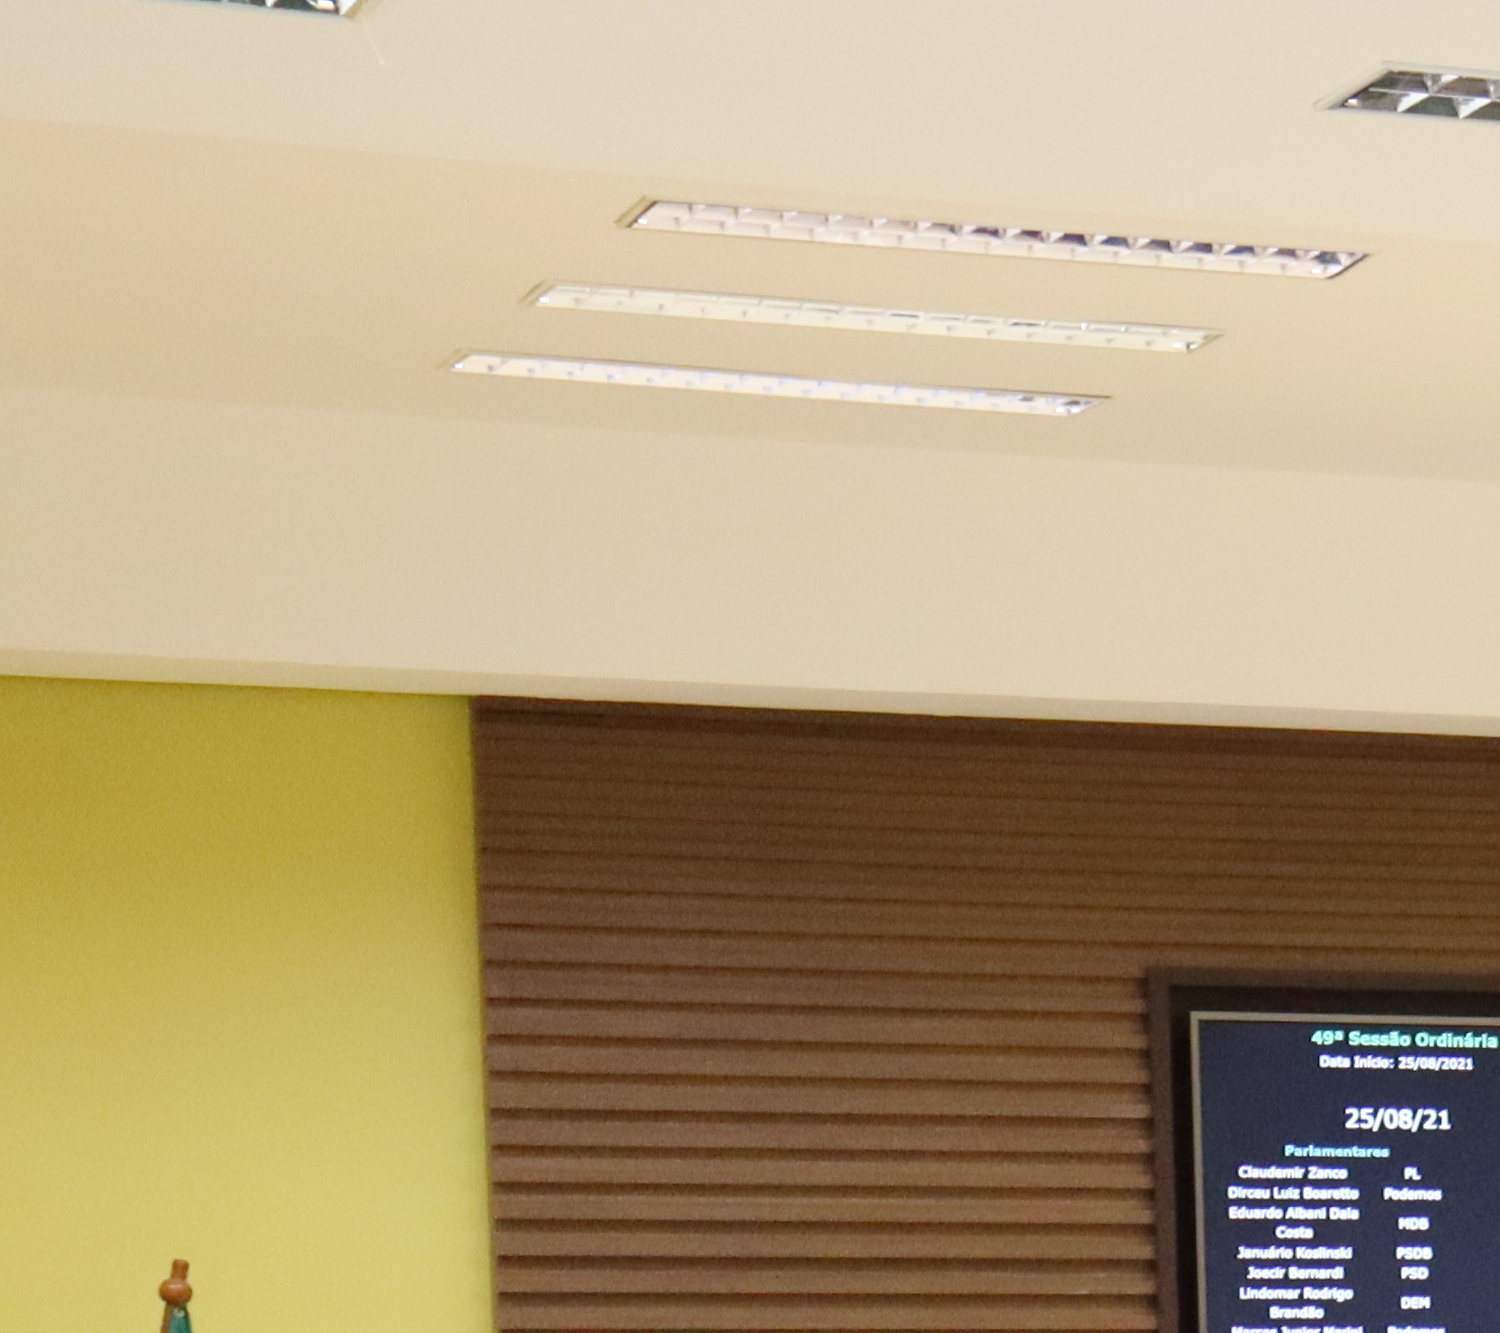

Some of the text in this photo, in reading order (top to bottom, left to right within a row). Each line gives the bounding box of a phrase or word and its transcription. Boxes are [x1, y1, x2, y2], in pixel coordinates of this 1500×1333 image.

[1311, 1029, 1344, 1045] 49ª
[1349, 1030, 1411, 1046] Sessão
[1415, 1031, 1498, 1048] Ordinária
[1319, 1052, 1473, 1071] Data Início: 25/08/2021
[1345, 1106, 1451, 1132] 25/08/21
[1285, 1144, 1390, 1157] Parlamentares
[1238, 1164, 1348, 1179] Claudemir Zanco
[1404, 1166, 1422, 1180] PL
[1273, 1184, 1300, 1199] Luiz
[1302, 1184, 1360, 1200] Boaretto
[1384, 1186, 1442, 1201] Podemos
[1229, 1205, 1284, 1219] Eduardo
[1285, 1205, 1327, 1219] Albani
[1398, 1216, 1430, 1230] MDB
[1275, 1224, 1314, 1239] Costa
[1396, 1245, 1433, 1260] PSDB
[1288, 1264, 1344, 1279] Bernardi
[1401, 1265, 1430, 1280] PSD
[1239, 1285, 1354, 1302] Lindomar Rodrigo
[1401, 1294, 1431, 1309] DEM
[1269, 1304, 1325, 1319] Brandão
